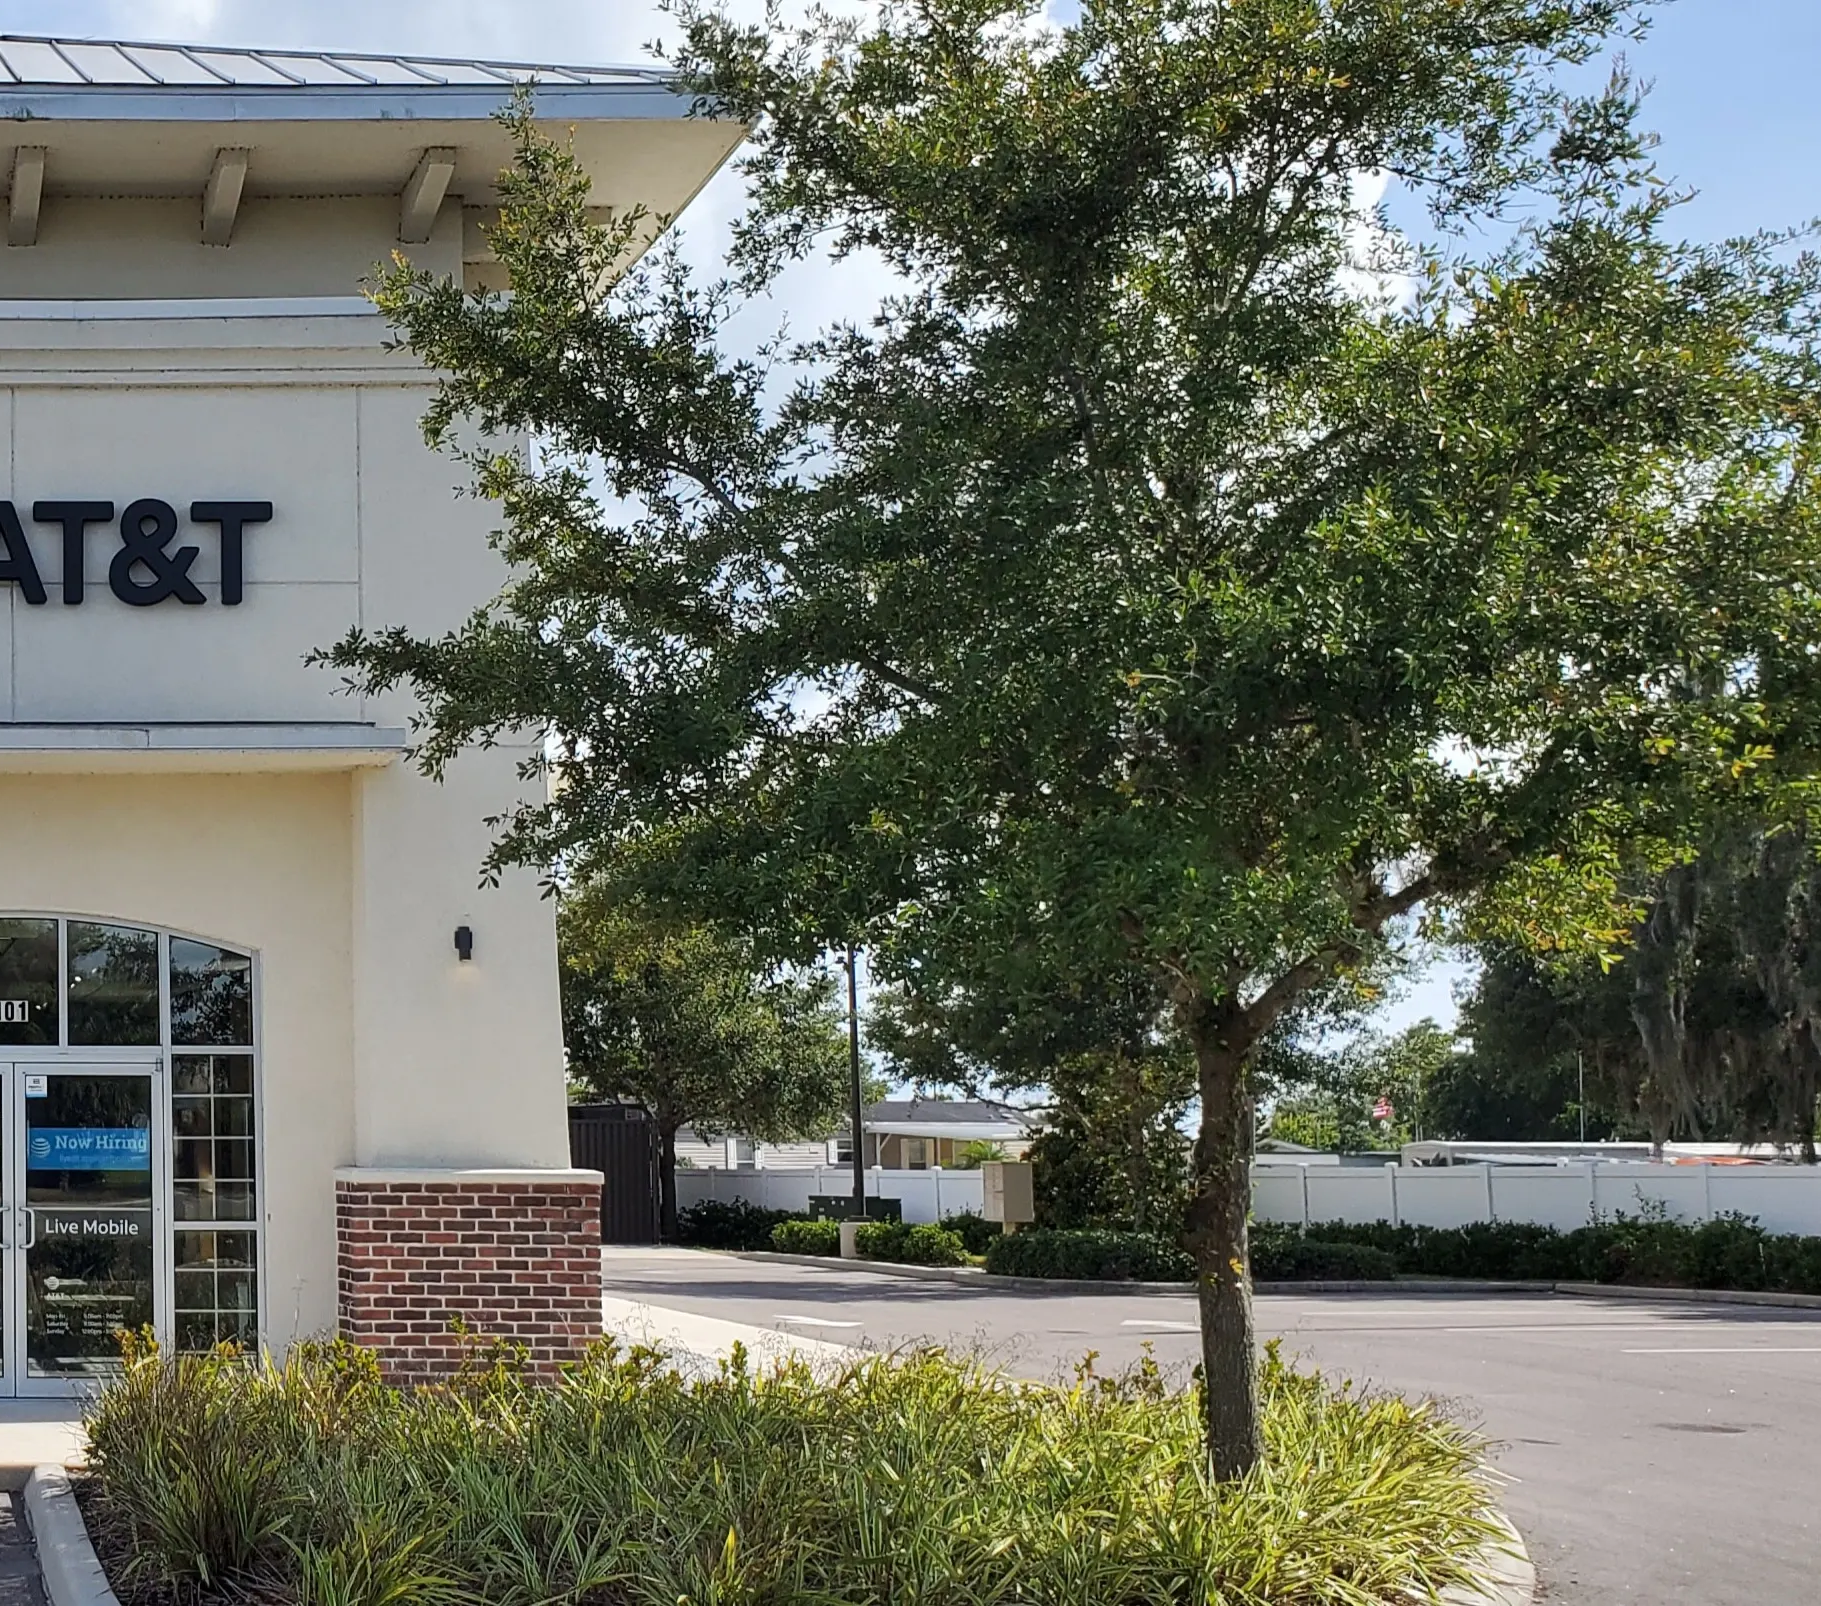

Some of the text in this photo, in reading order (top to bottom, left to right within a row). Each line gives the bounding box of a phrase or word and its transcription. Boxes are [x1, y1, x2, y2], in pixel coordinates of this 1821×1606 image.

[55, 1134, 147, 1153] Now Hiring
[45, 1218, 139, 1235] Live Mobile
